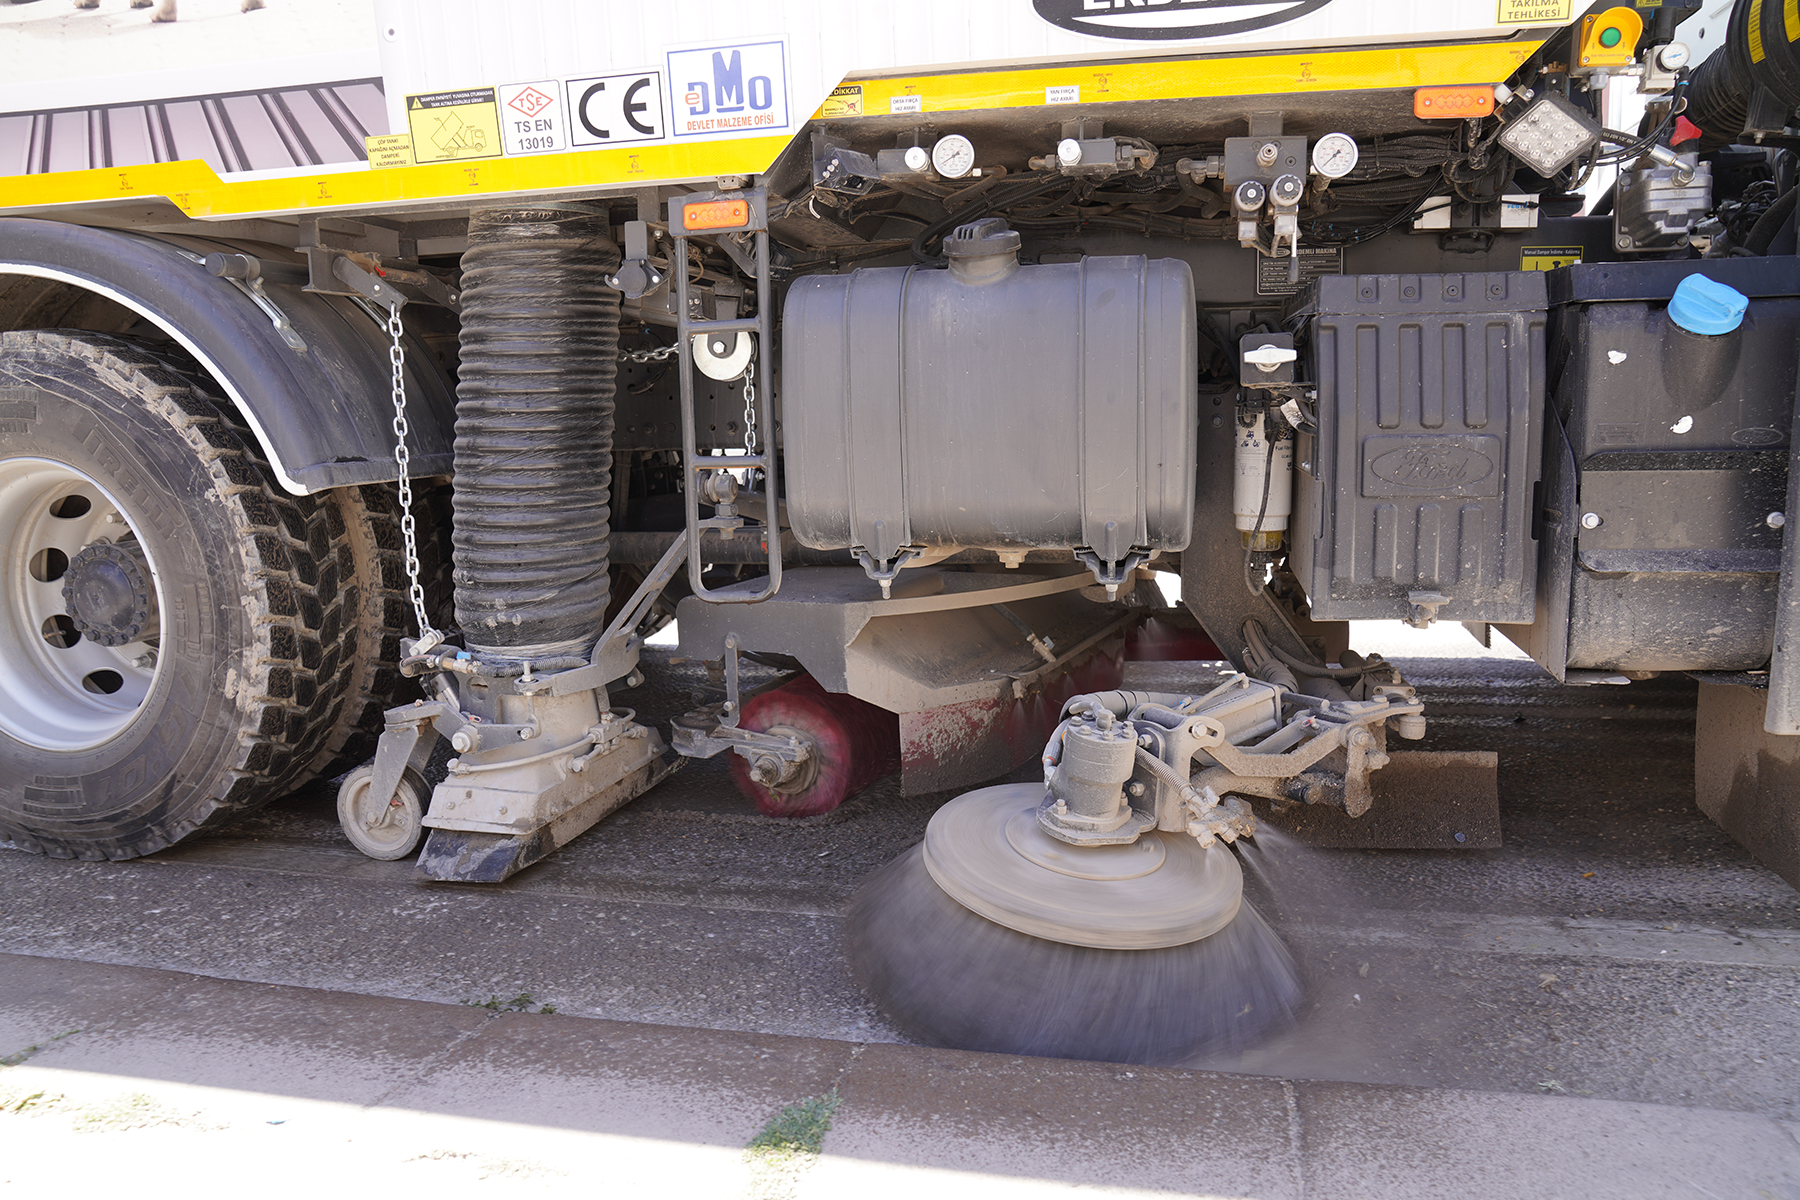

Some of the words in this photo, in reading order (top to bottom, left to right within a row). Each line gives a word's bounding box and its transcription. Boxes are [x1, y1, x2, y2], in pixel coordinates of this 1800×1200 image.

[1511, 0, 1559, 8] TAKILMA
[1507, 7, 1561, 19] TEHLİKESİ
[518, 93, 543, 111] TSE
[578, 77, 655, 139] CE
[514, 120, 531, 133] TS
[535, 118, 553, 131] EN
[687, 118, 715, 131] DEVLET
[716, 115, 753, 129] MALZEME
[754, 112, 774, 125] OFİSİ
[518, 136, 554, 151] 13019
[1394, 450, 1469, 481] Ford
